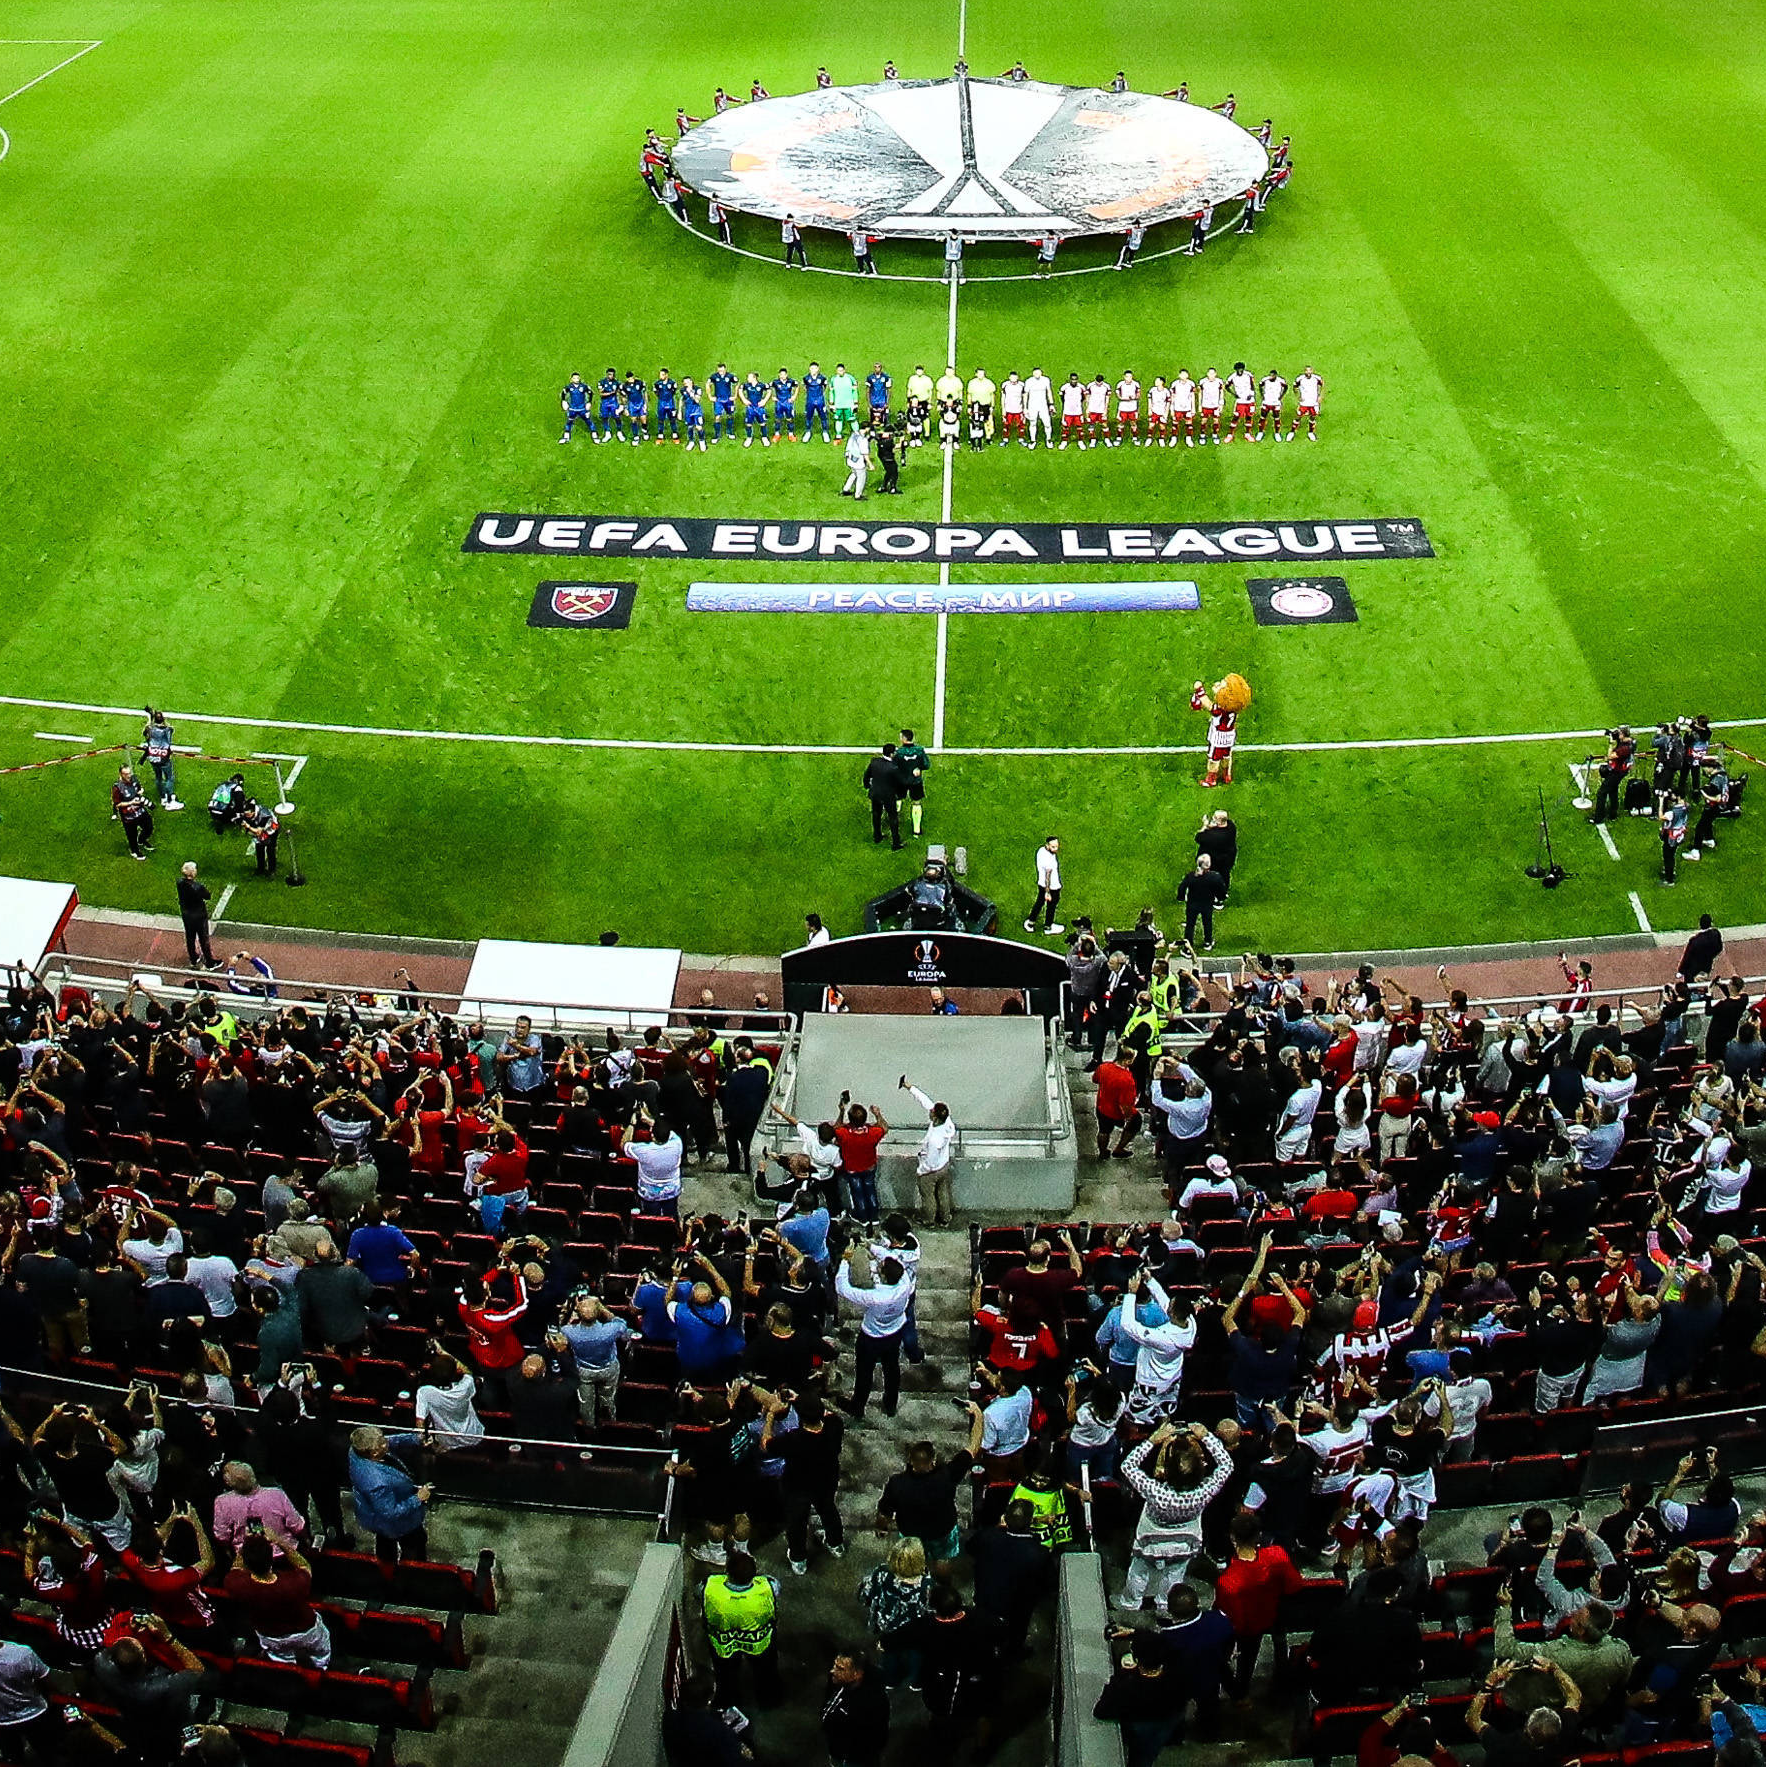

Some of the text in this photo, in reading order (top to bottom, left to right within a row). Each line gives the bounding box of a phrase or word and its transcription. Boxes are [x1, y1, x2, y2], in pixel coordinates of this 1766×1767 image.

[477, 518, 689, 553] UEFA
[711, 523, 1039, 557] EUROPA
[1060, 524, 1385, 557] LEAGUE
[808, 589, 935, 608] PEACE
[907, 970, 947, 979] EUROPA
[1011, 1343, 1027, 1361] 7
